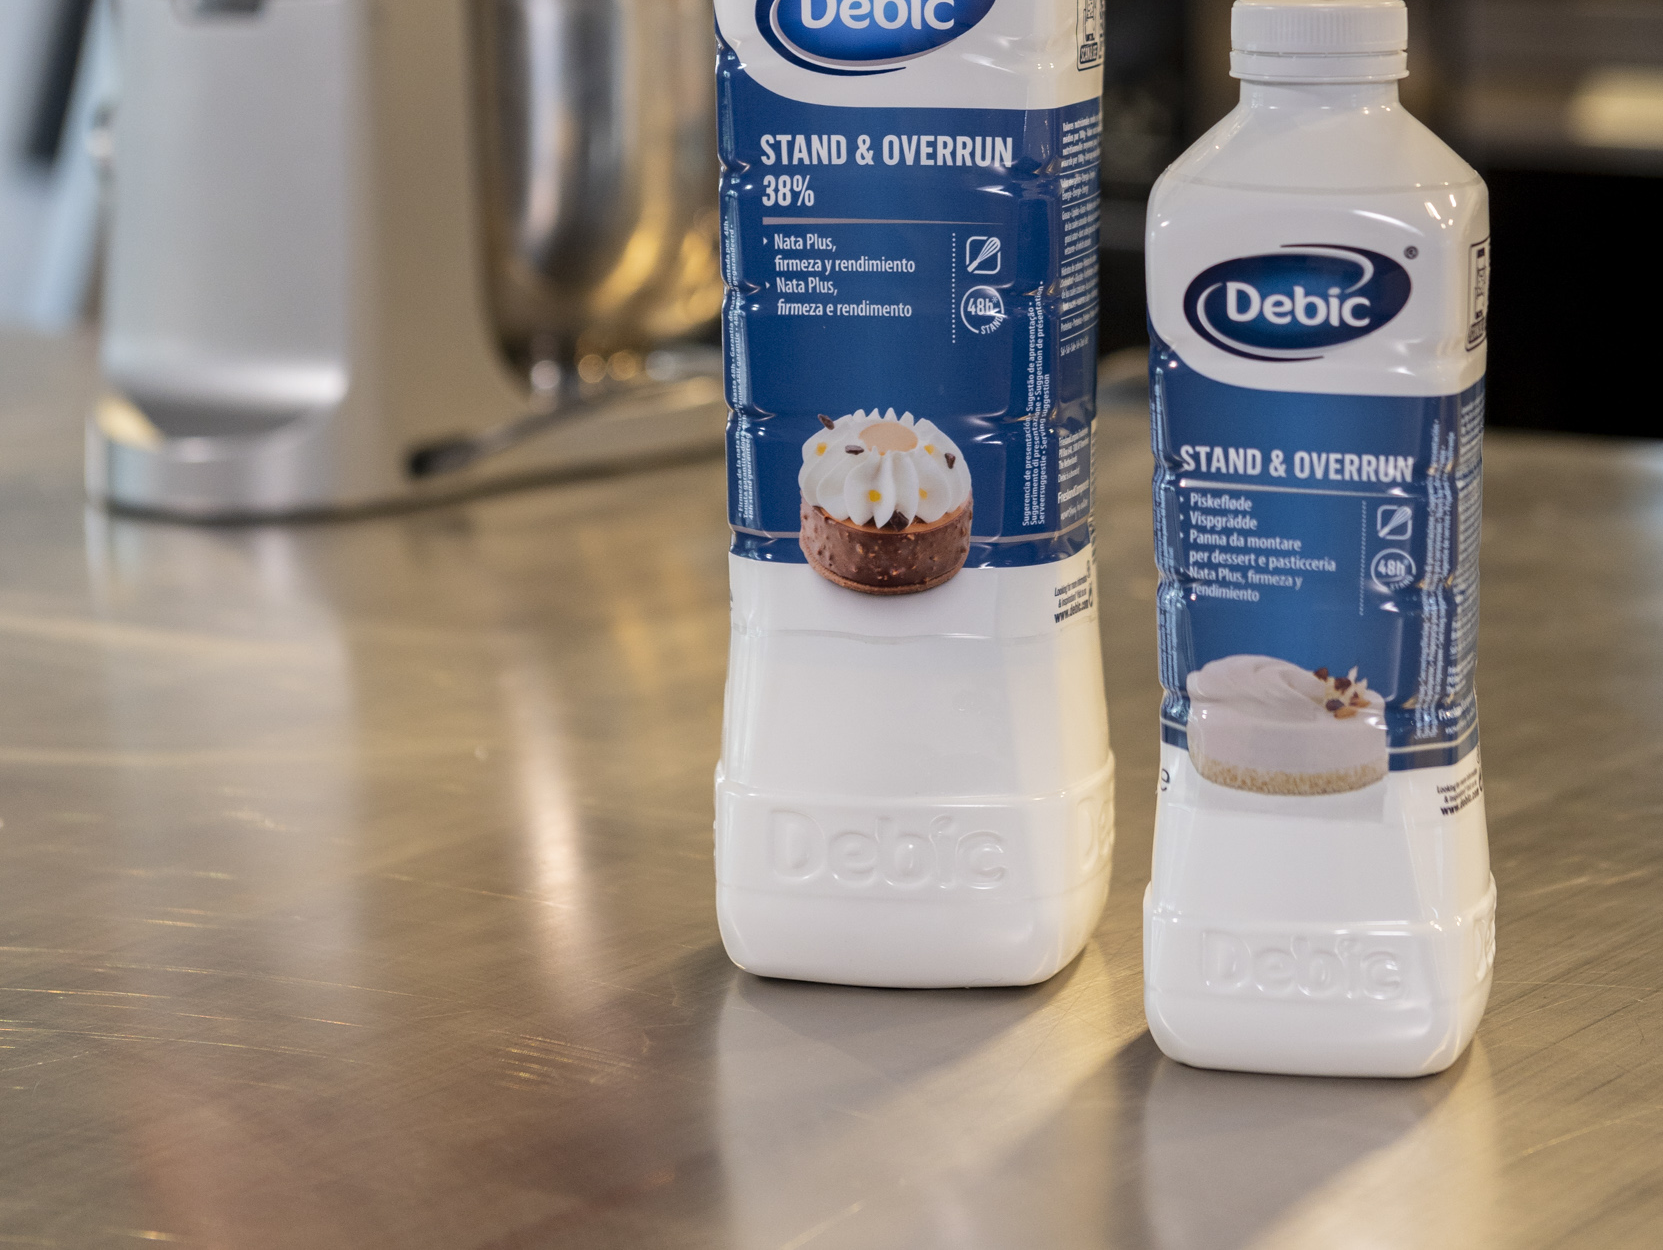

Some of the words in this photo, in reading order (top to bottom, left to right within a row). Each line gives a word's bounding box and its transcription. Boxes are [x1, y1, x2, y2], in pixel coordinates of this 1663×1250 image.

[760, 134, 847, 166] STAND
[855, 134, 874, 166] &
[882, 134, 1013, 168] OVERRUN
[761, 175, 815, 207] 38%
[774, 234, 803, 250] Nata
[806, 234, 836, 252] Plus,
[775, 255, 823, 272] firmeza
[824, 259, 833, 276] y
[835, 256, 915, 273] rendimiento
[776, 277, 805, 293] Nata
[808, 278, 838, 296] Plus,
[777, 299, 823, 316] firmeza
[826, 303, 834, 316] e
[837, 300, 912, 317] rendimento
[1225, 281, 1371, 327] Debic
[1028, 307, 1037, 361] apresentação
[1028, 362, 1035, 373] de
[1026, 374, 1035, 412] Sugestão
[1024, 417, 1033, 469] presentación
[1031, 468, 1039, 525] Suggerimento
[1037, 338, 1043, 349] de
[1039, 418, 1048, 449] Serving
[1024, 470, 1031, 481] de
[1180, 444, 1262, 477] STAND
[1268, 449, 1287, 478] &
[1293, 451, 1414, 483] OVERRUN
[1023, 482, 1031, 526] Sugerencia
[1039, 455, 1047, 525] Serveersuggestie
[1189, 492, 1252, 512] Piskefløde
[1189, 511, 1258, 531] Vispgrädde
[1189, 530, 1227, 547] Panna
[1229, 532, 1245, 548] da
[1247, 536, 1302, 552] montare
[1189, 551, 1209, 566] per
[1211, 551, 1257, 568] dessert
[1258, 555, 1267, 568] e
[1268, 555, 1337, 573] pasticceria
[1188, 566, 1217, 582] Nata
[1218, 567, 1246, 586] Plus,
[1247, 569, 1293, 587] firmeza
[1294, 575, 1303, 590] y
[1192, 581, 1260, 602] rendimiento
[769, 810, 1009, 890] Debic
[1202, 930, 1402, 1000] Debic
